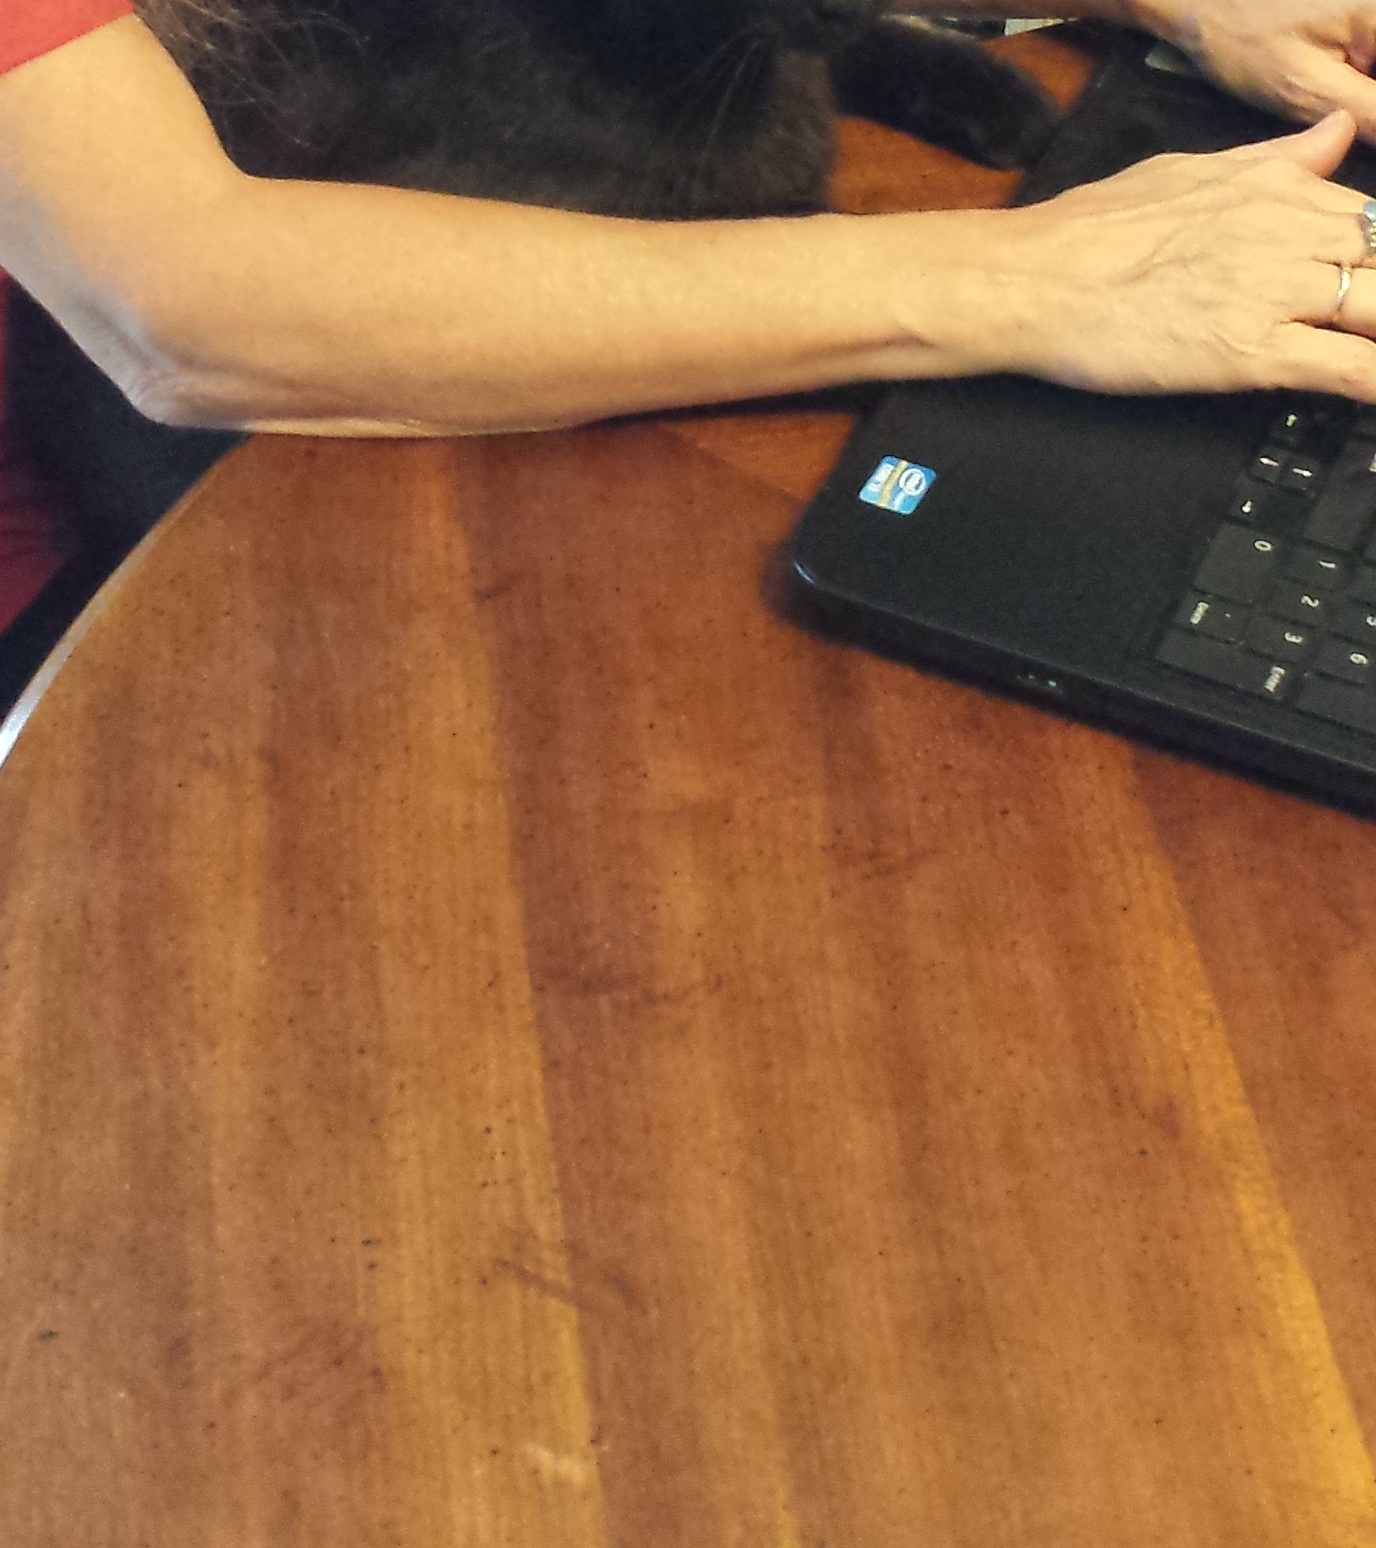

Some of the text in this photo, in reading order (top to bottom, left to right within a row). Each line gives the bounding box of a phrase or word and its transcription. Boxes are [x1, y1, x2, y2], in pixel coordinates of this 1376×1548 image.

[1254, 540, 1272, 552] 0
[1319, 560, 1336, 569] 1
[1301, 595, 1320, 608] 2
[1284, 632, 1303, 644] 3
[1349, 653, 1369, 665] 6
